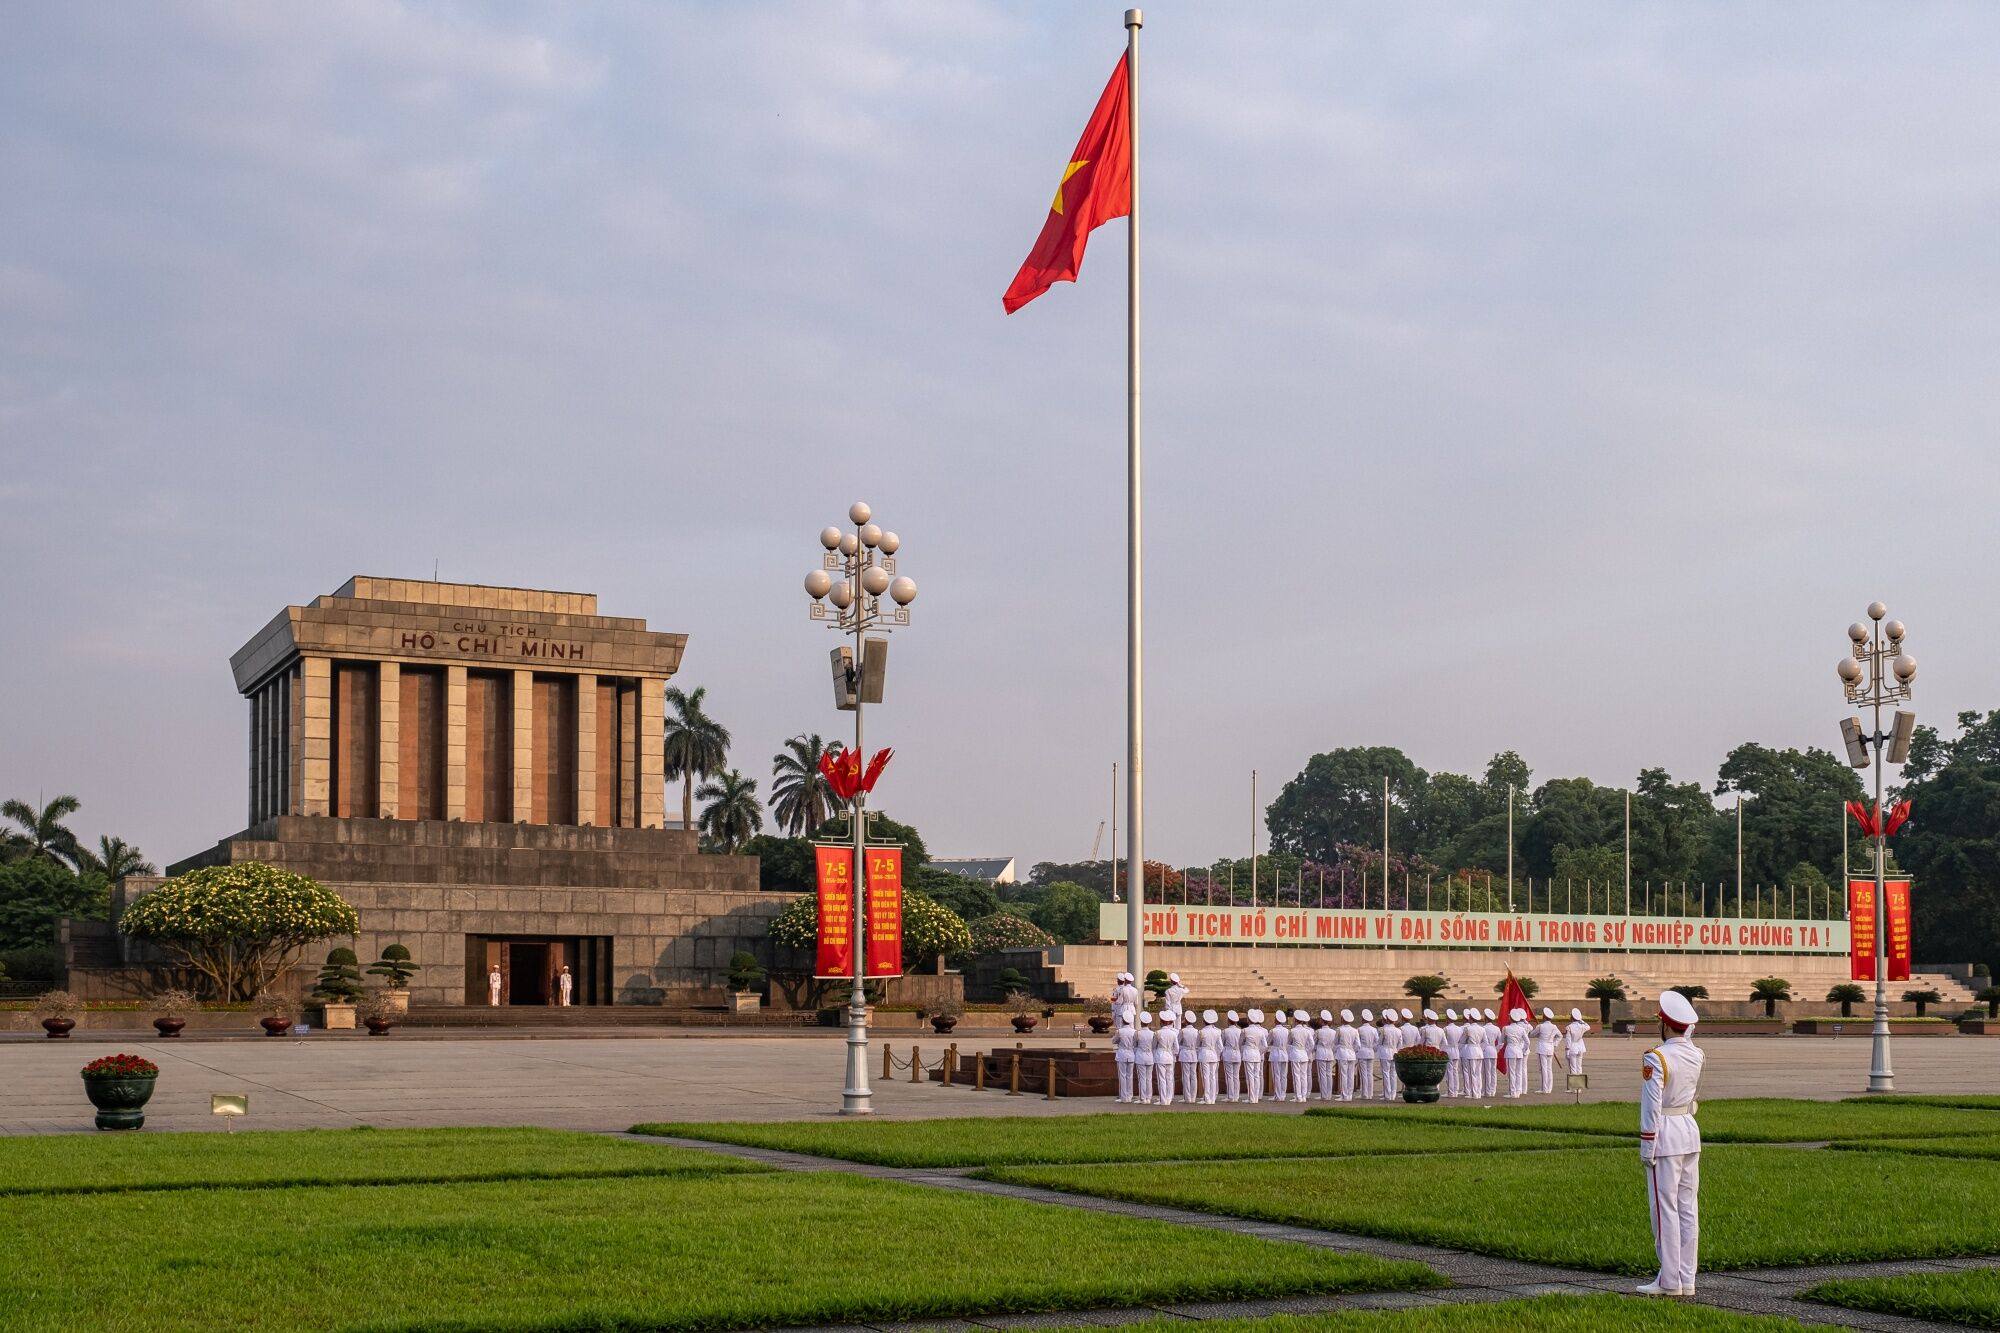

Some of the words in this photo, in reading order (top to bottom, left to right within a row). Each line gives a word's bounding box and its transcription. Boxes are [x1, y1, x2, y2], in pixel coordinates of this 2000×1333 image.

[825, 863, 846, 876] 7-5
[874, 859, 894, 872] 7-5
[1856, 891, 1871, 903] 7-5
[1186, 913, 1232, 940] TỊCH
[1240, 908, 1266, 937] HỒ
[1275, 909, 1308, 938] CHÍ
[1316, 916, 1367, 939] MINH
[1375, 914, 1393, 940] VĨ
[1401, 918, 1432, 944] ĐẠI
[1440, 913, 1490, 941] SỐNG
[1498, 916, 1531, 942] MÃI
[1539, 920, 1596, 943] TRONG
[1603, 920, 1627, 947] SỰ
[1632, 920, 1694, 948] NGHIỆP
[1700, 919, 1732, 946] CỦA
[1739, 921, 1793, 946] CHÚNG
[1800, 926, 1819, 947] TA
